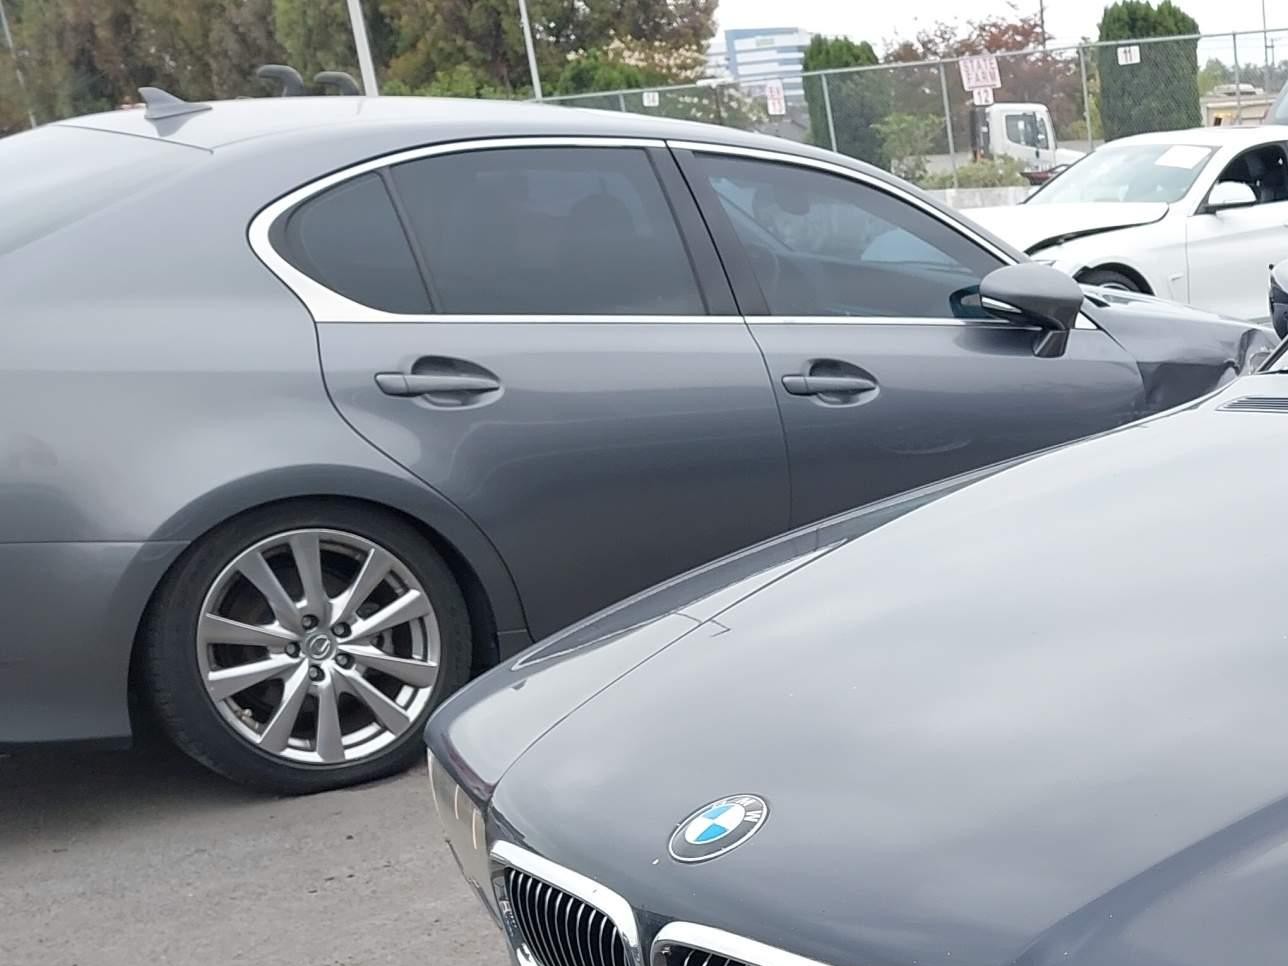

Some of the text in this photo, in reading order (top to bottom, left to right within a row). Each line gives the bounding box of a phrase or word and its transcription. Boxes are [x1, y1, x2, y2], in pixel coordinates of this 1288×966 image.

[960, 57, 996, 72] STATE
[965, 70, 998, 84] FARM
[976, 88, 991, 104] 12
